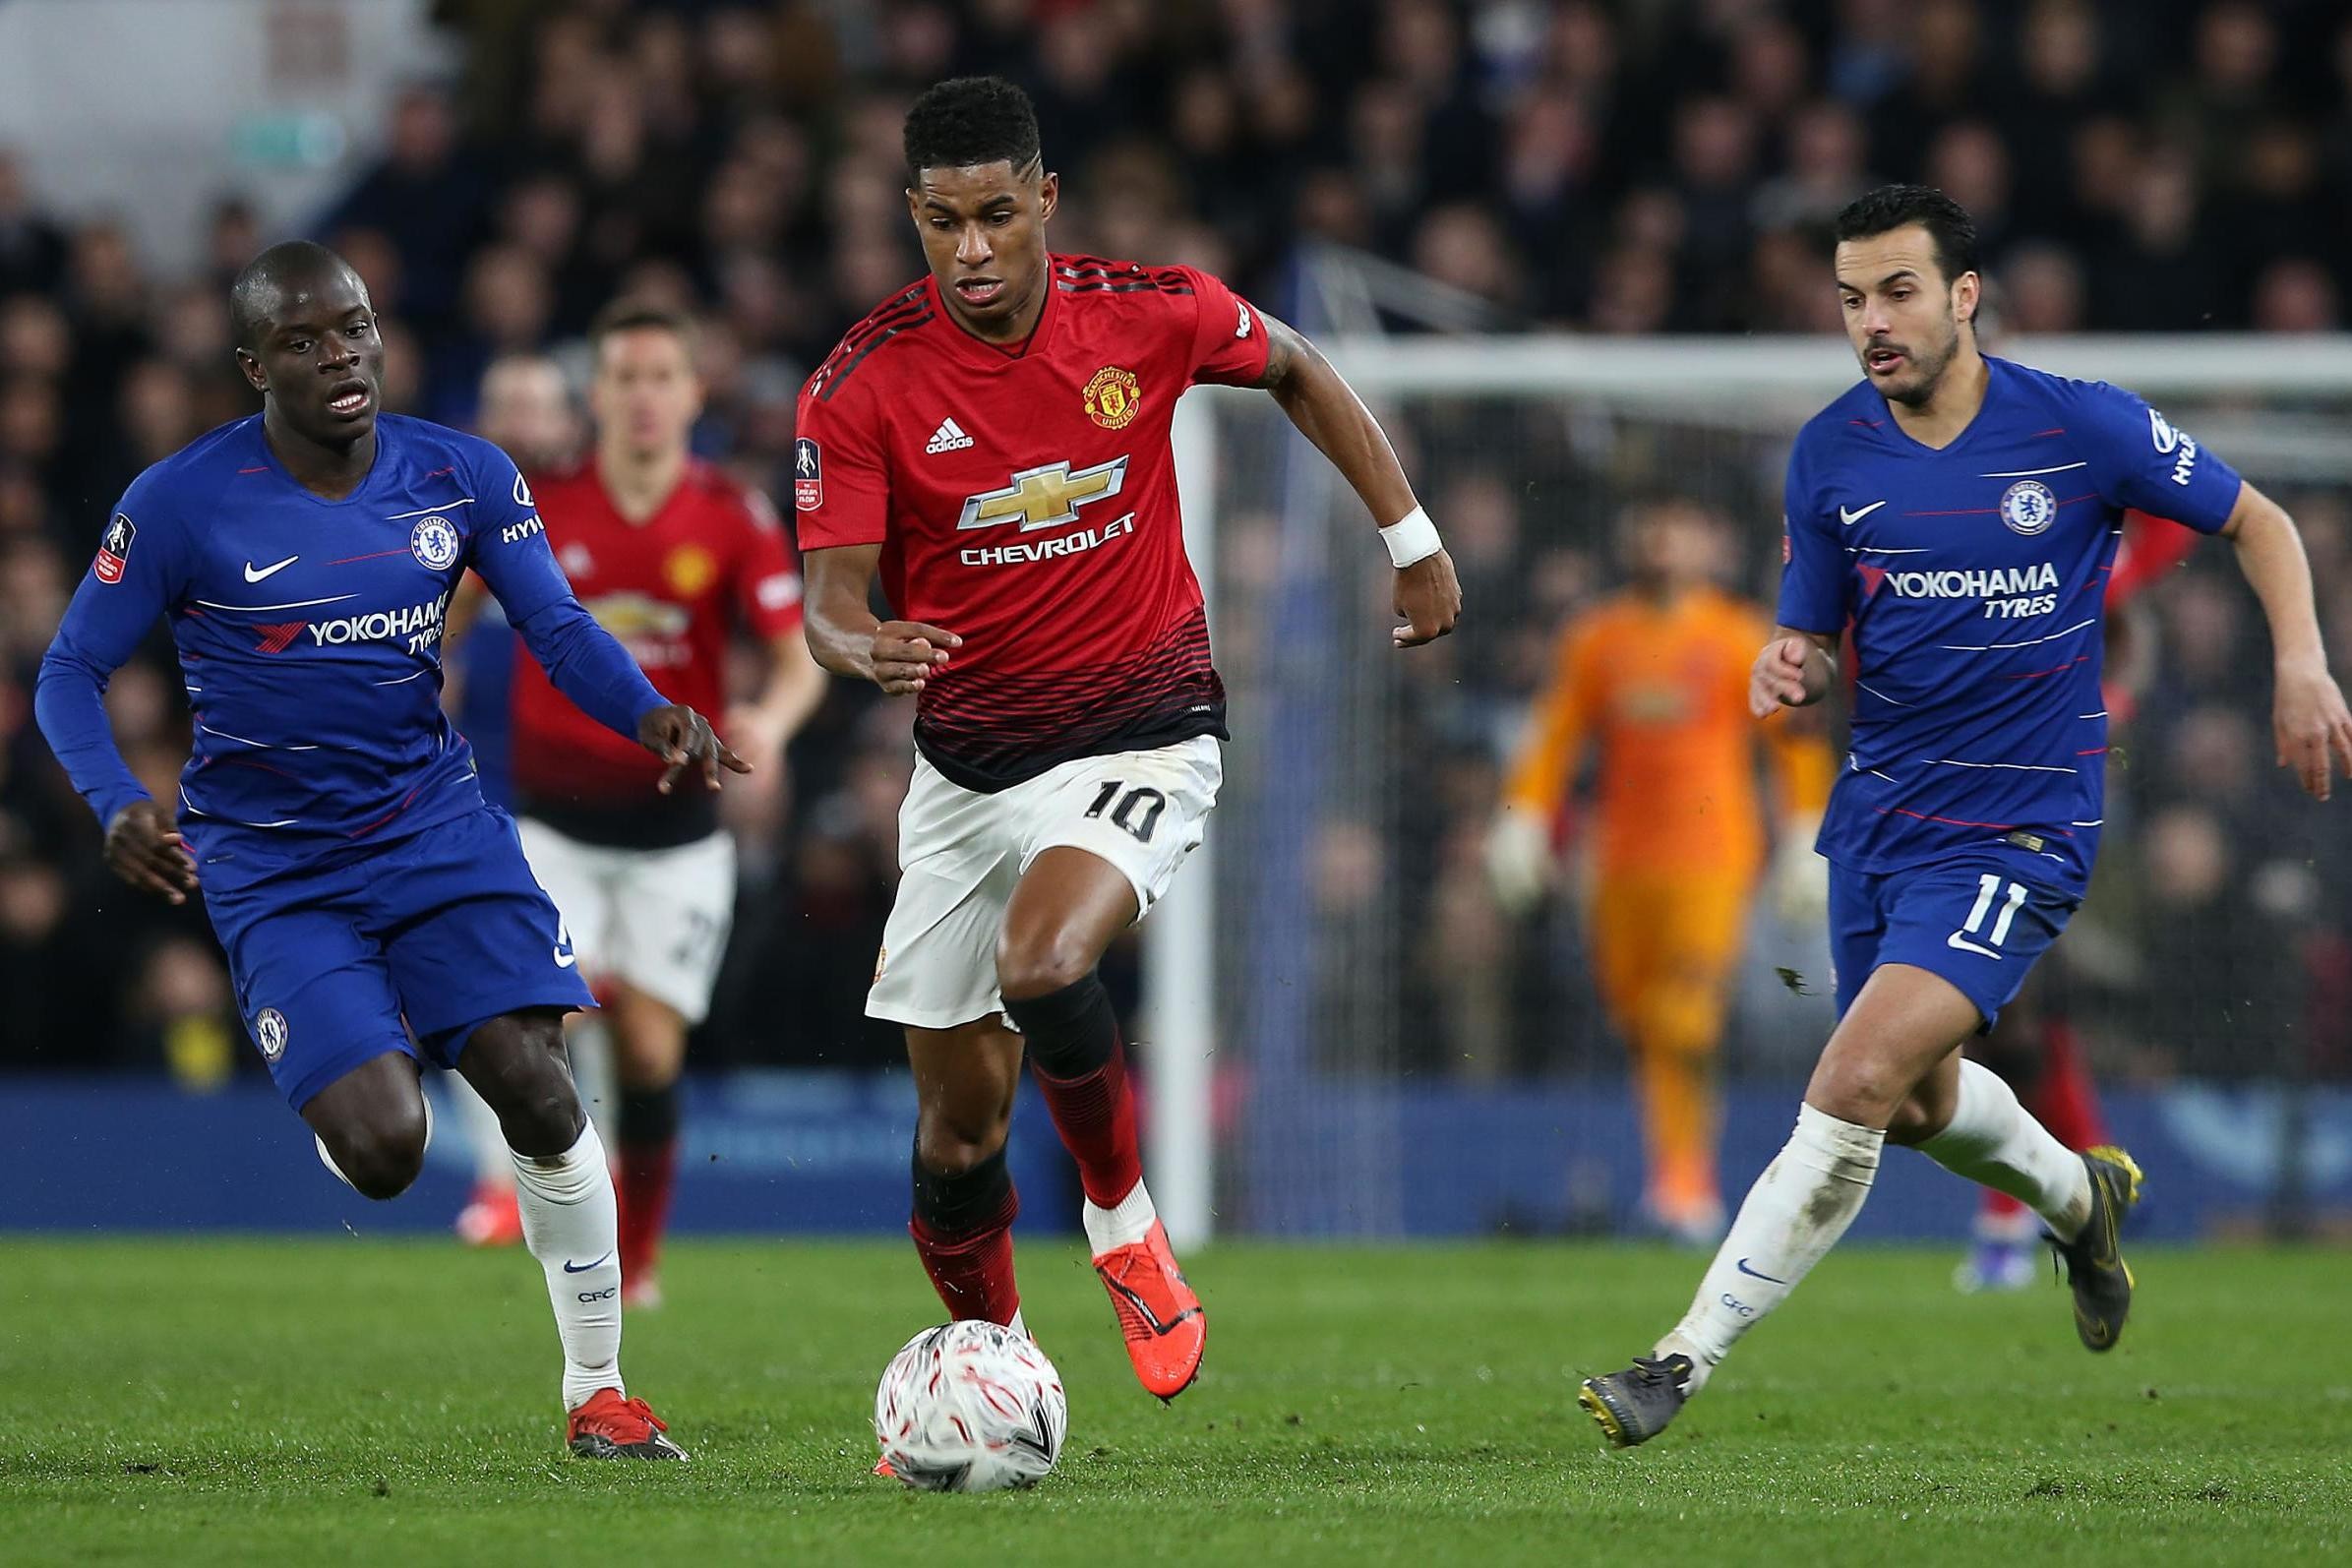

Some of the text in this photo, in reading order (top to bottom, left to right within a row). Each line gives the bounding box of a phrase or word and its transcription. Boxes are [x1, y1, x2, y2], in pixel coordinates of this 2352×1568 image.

[926, 436, 974, 455] adidas
[415, 518, 447, 534] CHELSEA
[961, 512, 1136, 566] CHEVROLET
[1884, 562, 2060, 598] YOKOHAMA
[1984, 592, 2058, 619] TYRES
[1084, 779, 1167, 844] 10
[1962, 874, 2028, 947] 11
[577, 1287, 616, 1304] CFC
